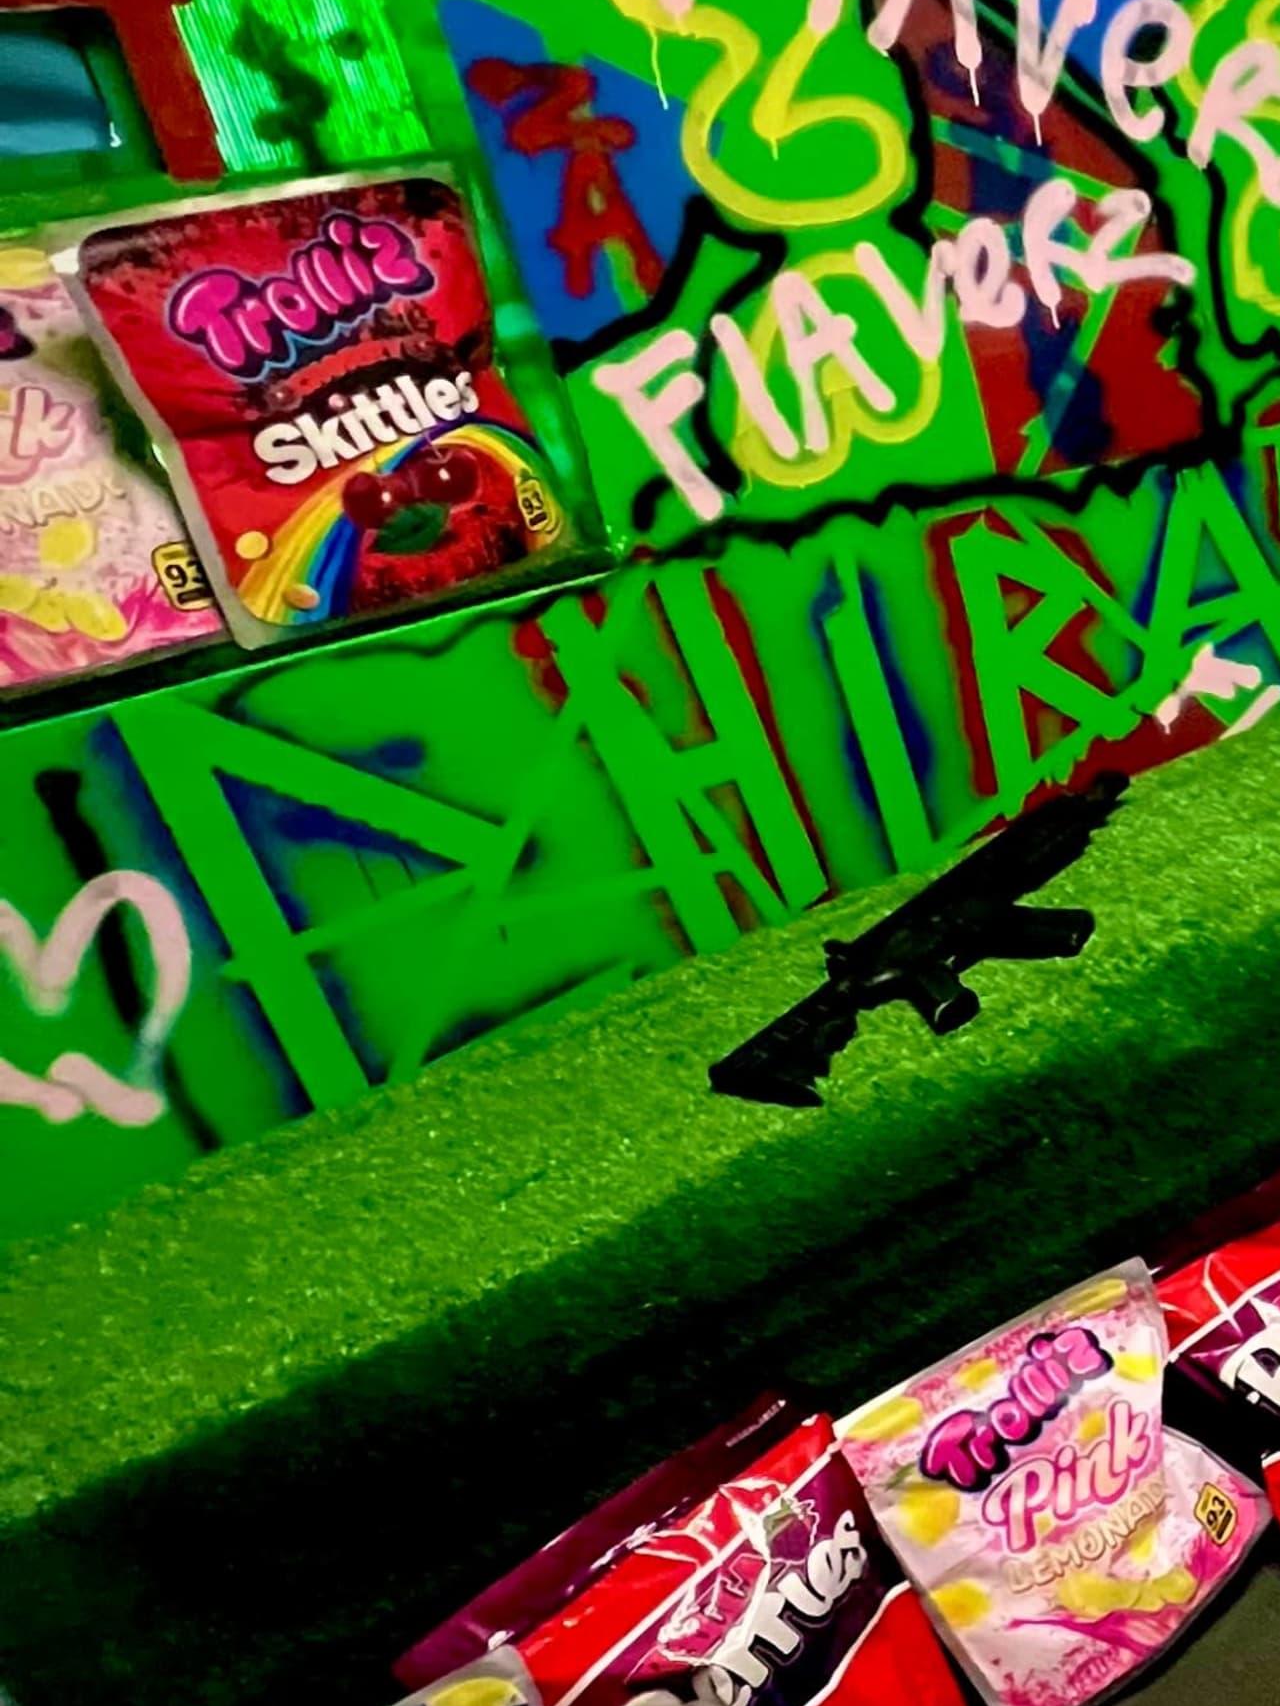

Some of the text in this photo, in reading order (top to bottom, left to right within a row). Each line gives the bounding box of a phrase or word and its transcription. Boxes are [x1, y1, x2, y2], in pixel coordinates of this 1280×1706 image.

[252, 371, 480, 485] Skittles
[918, 1323, 1105, 1491] Trolliz
[980, 1398, 1155, 1555] Pink
